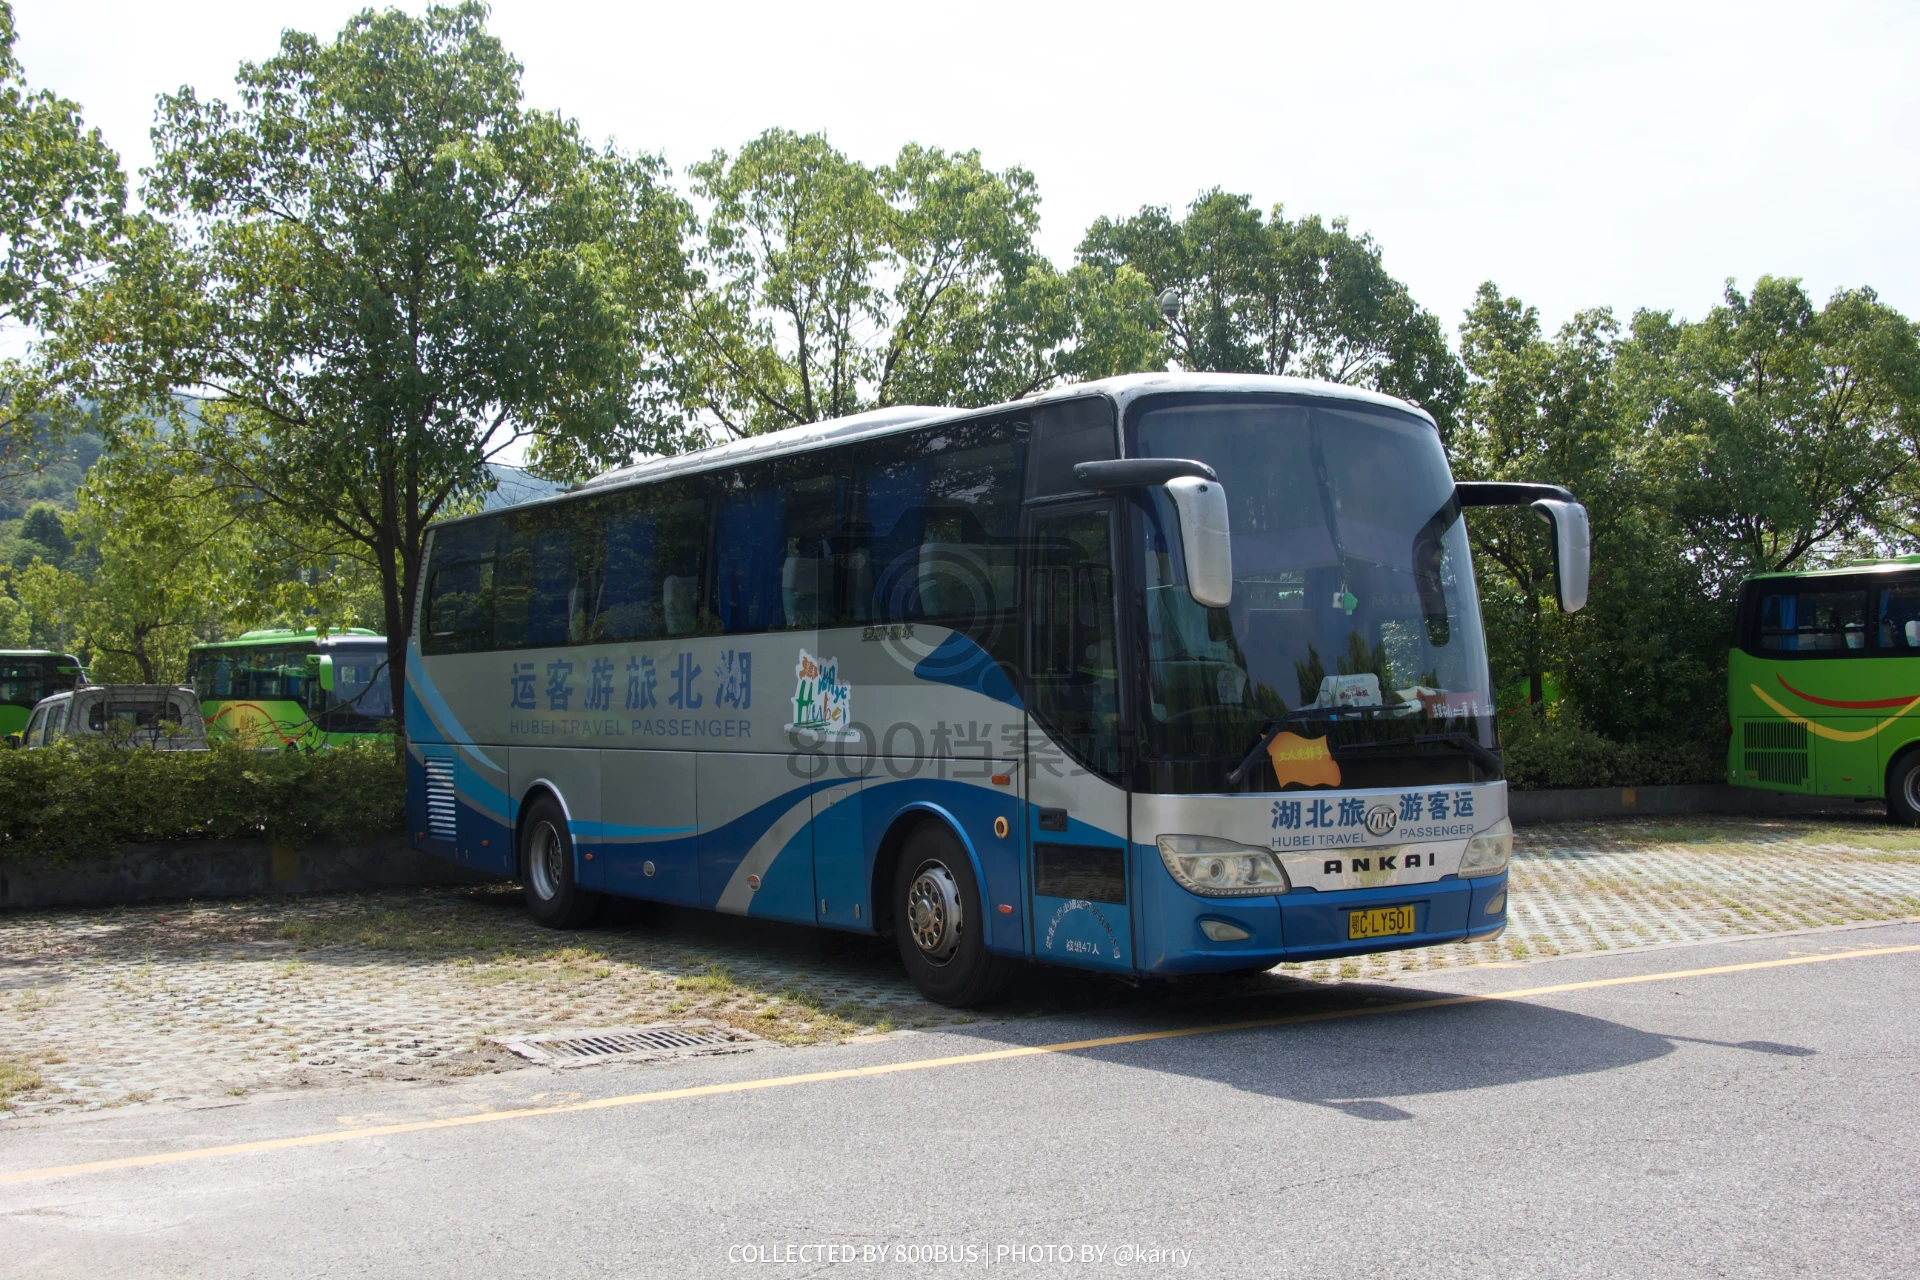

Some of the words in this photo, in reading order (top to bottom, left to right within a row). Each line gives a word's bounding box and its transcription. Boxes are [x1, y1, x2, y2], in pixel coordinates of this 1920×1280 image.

[796, 680, 847, 726] Hubei
[510, 719, 555, 735] HUBEI
[561, 719, 624, 736] TRAVEL
[631, 719, 751, 738] PASSENGER
[1271, 797, 1366, 830] 湖北旅
[1399, 791, 1475, 822] 游客运
[1271, 835, 1315, 847] HUBEI
[1318, 833, 1368, 845] TRAVEL
[1400, 824, 1475, 838] PASSENGER
[1324, 853, 1435, 875] ANKAI
